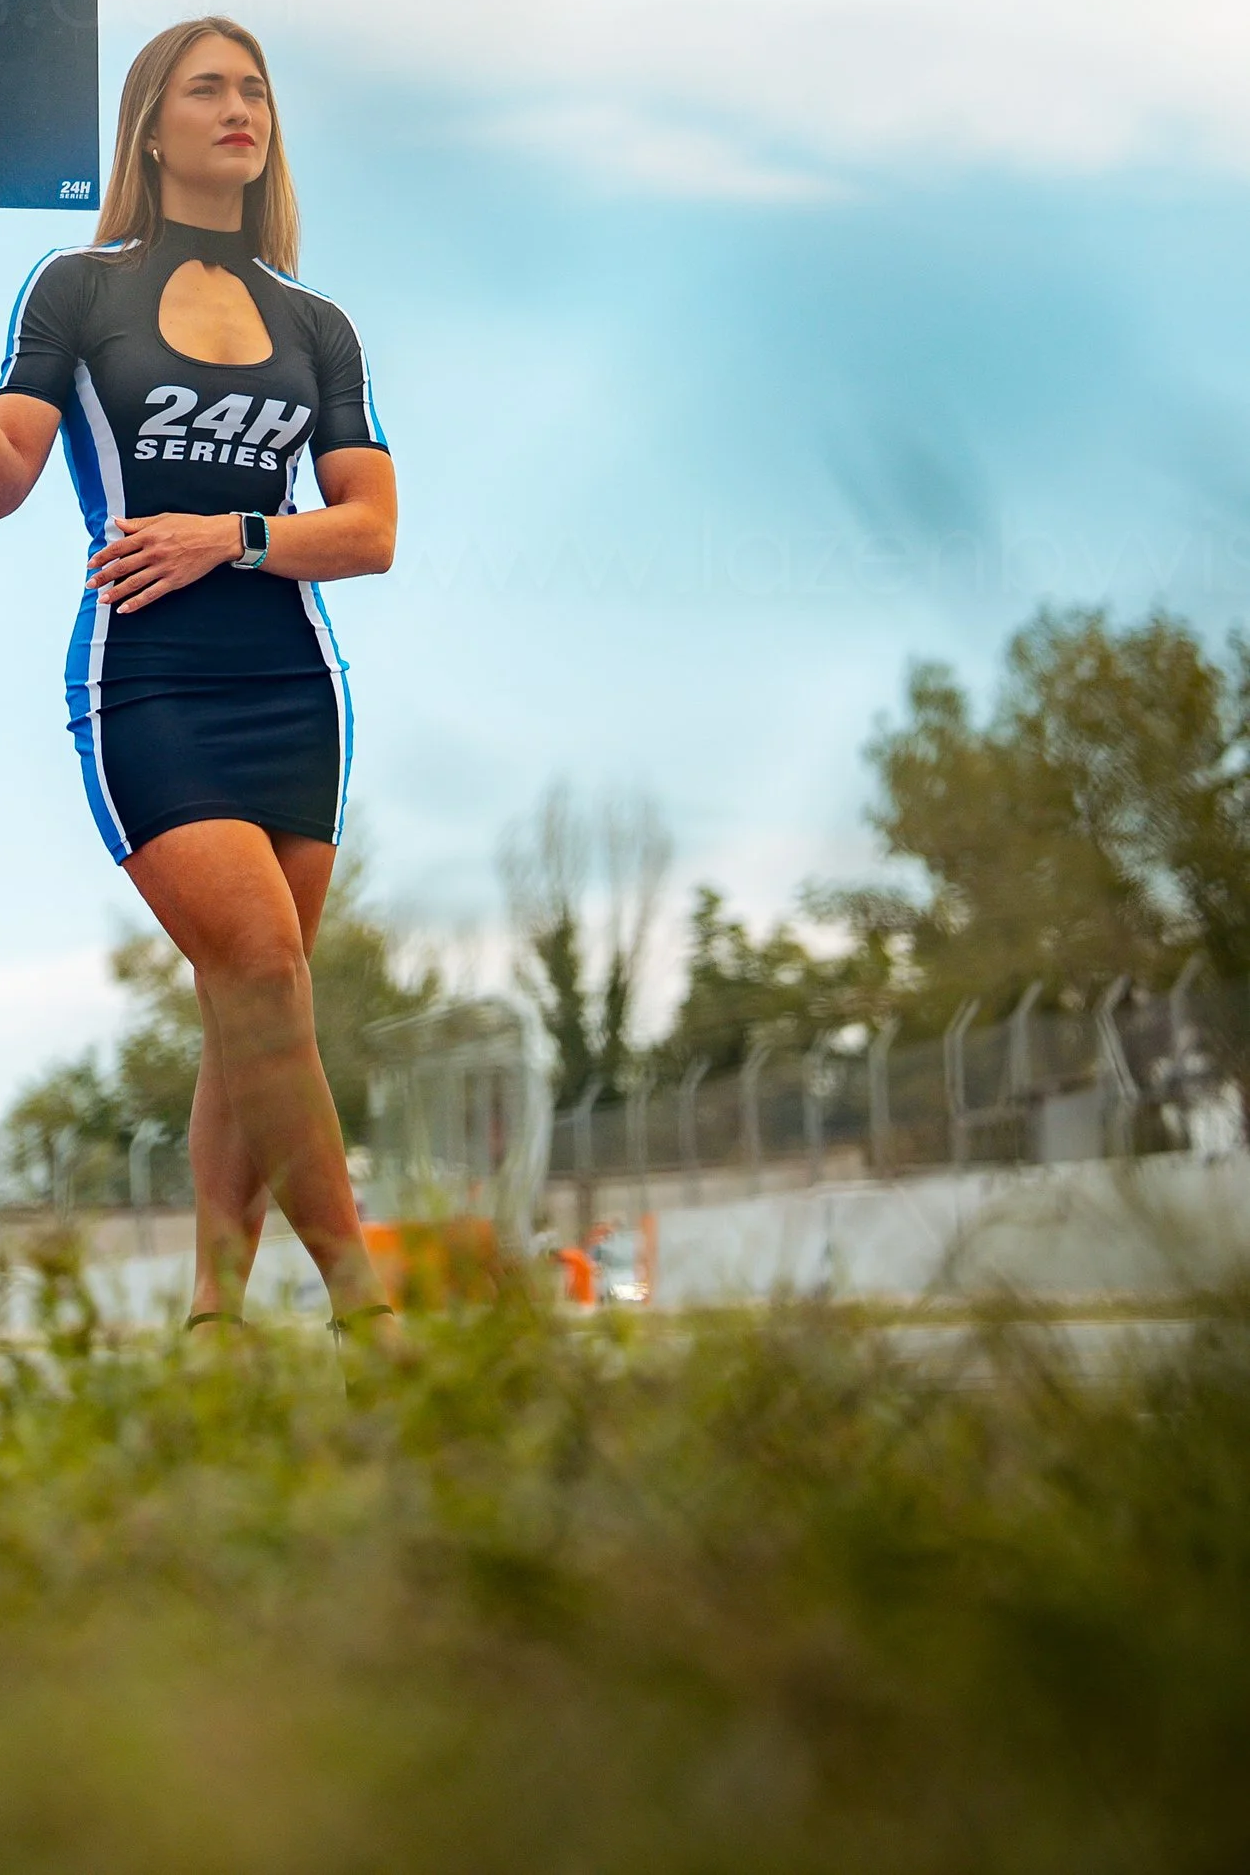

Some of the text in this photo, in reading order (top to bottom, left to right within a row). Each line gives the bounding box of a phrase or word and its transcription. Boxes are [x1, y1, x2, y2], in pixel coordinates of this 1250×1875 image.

[60, 180, 92, 194] 24H
[137, 385, 312, 451] 24H
[134, 438, 278, 471] SERIES
